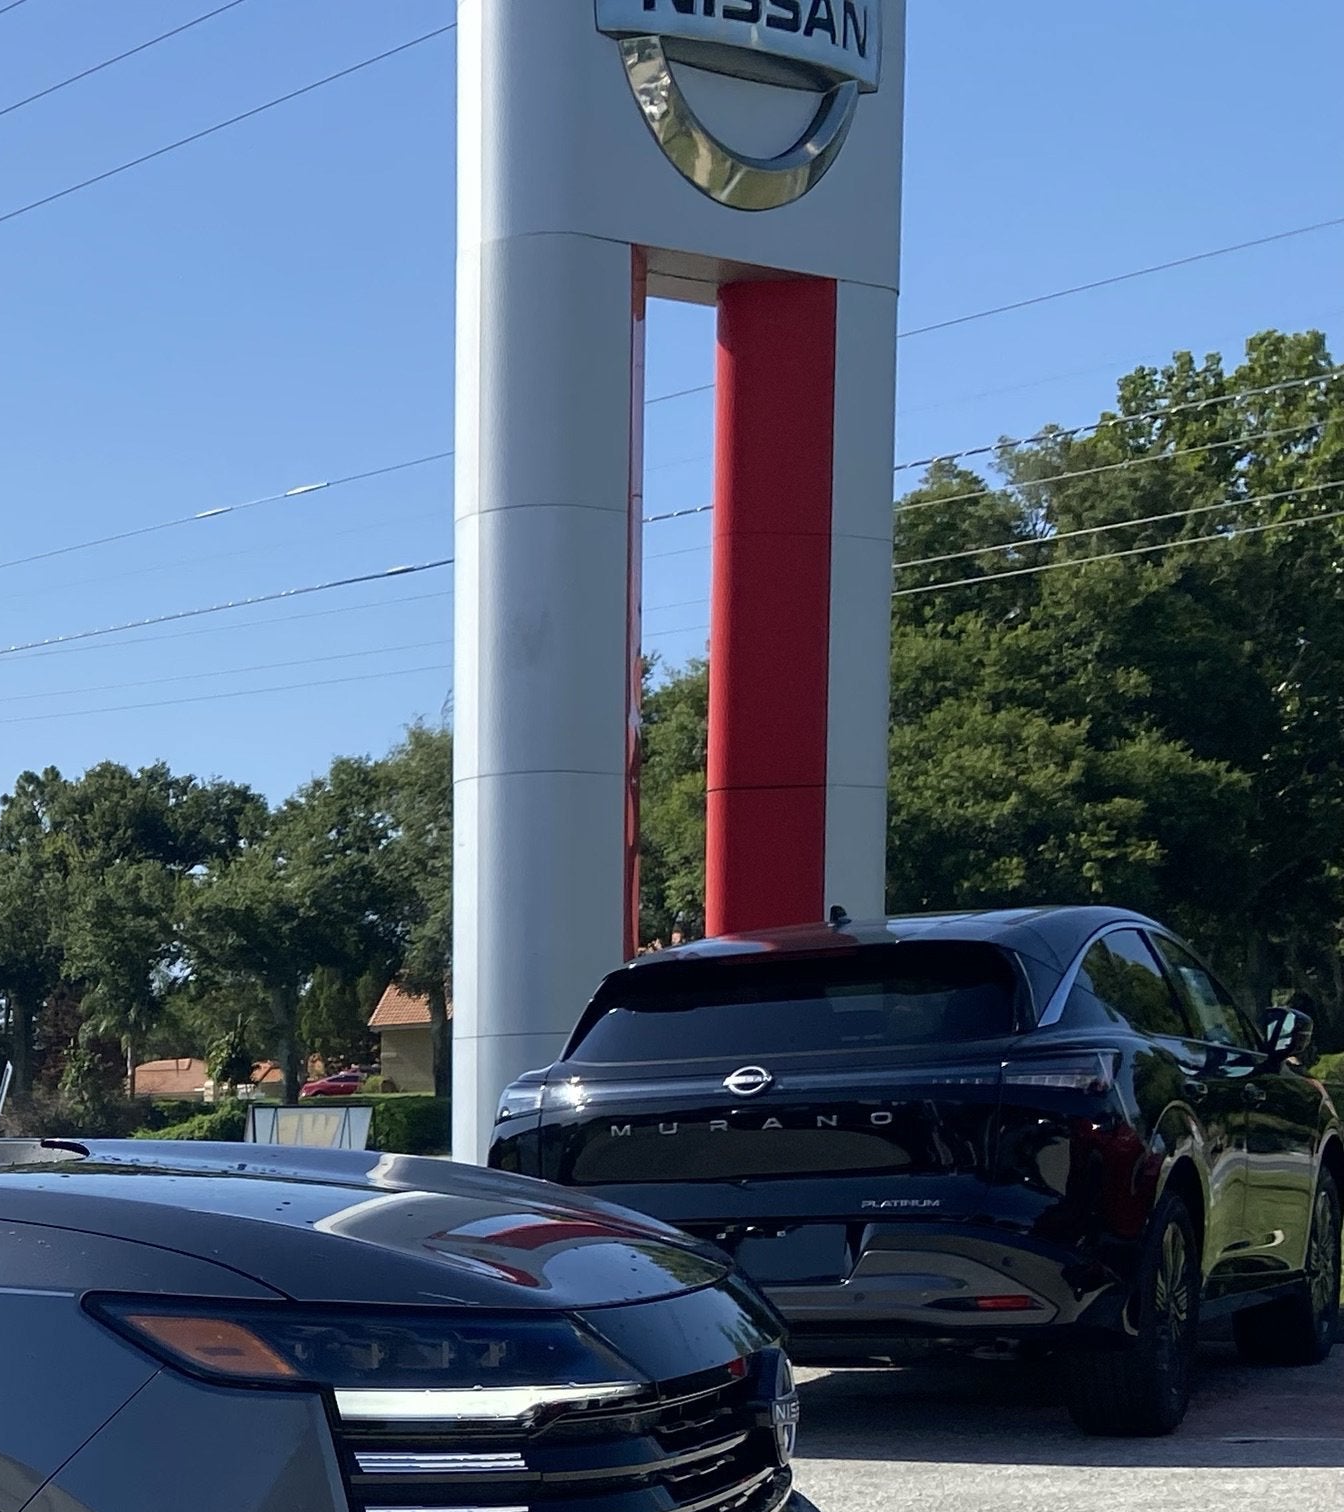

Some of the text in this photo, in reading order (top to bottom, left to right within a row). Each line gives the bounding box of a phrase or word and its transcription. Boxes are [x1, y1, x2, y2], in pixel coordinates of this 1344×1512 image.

[643, 0, 867, 58] SSAN
[723, 1075, 772, 1086] SAN
[611, 1111, 892, 1137] MURANO
[860, 1199, 941, 1209] PLATINUM
